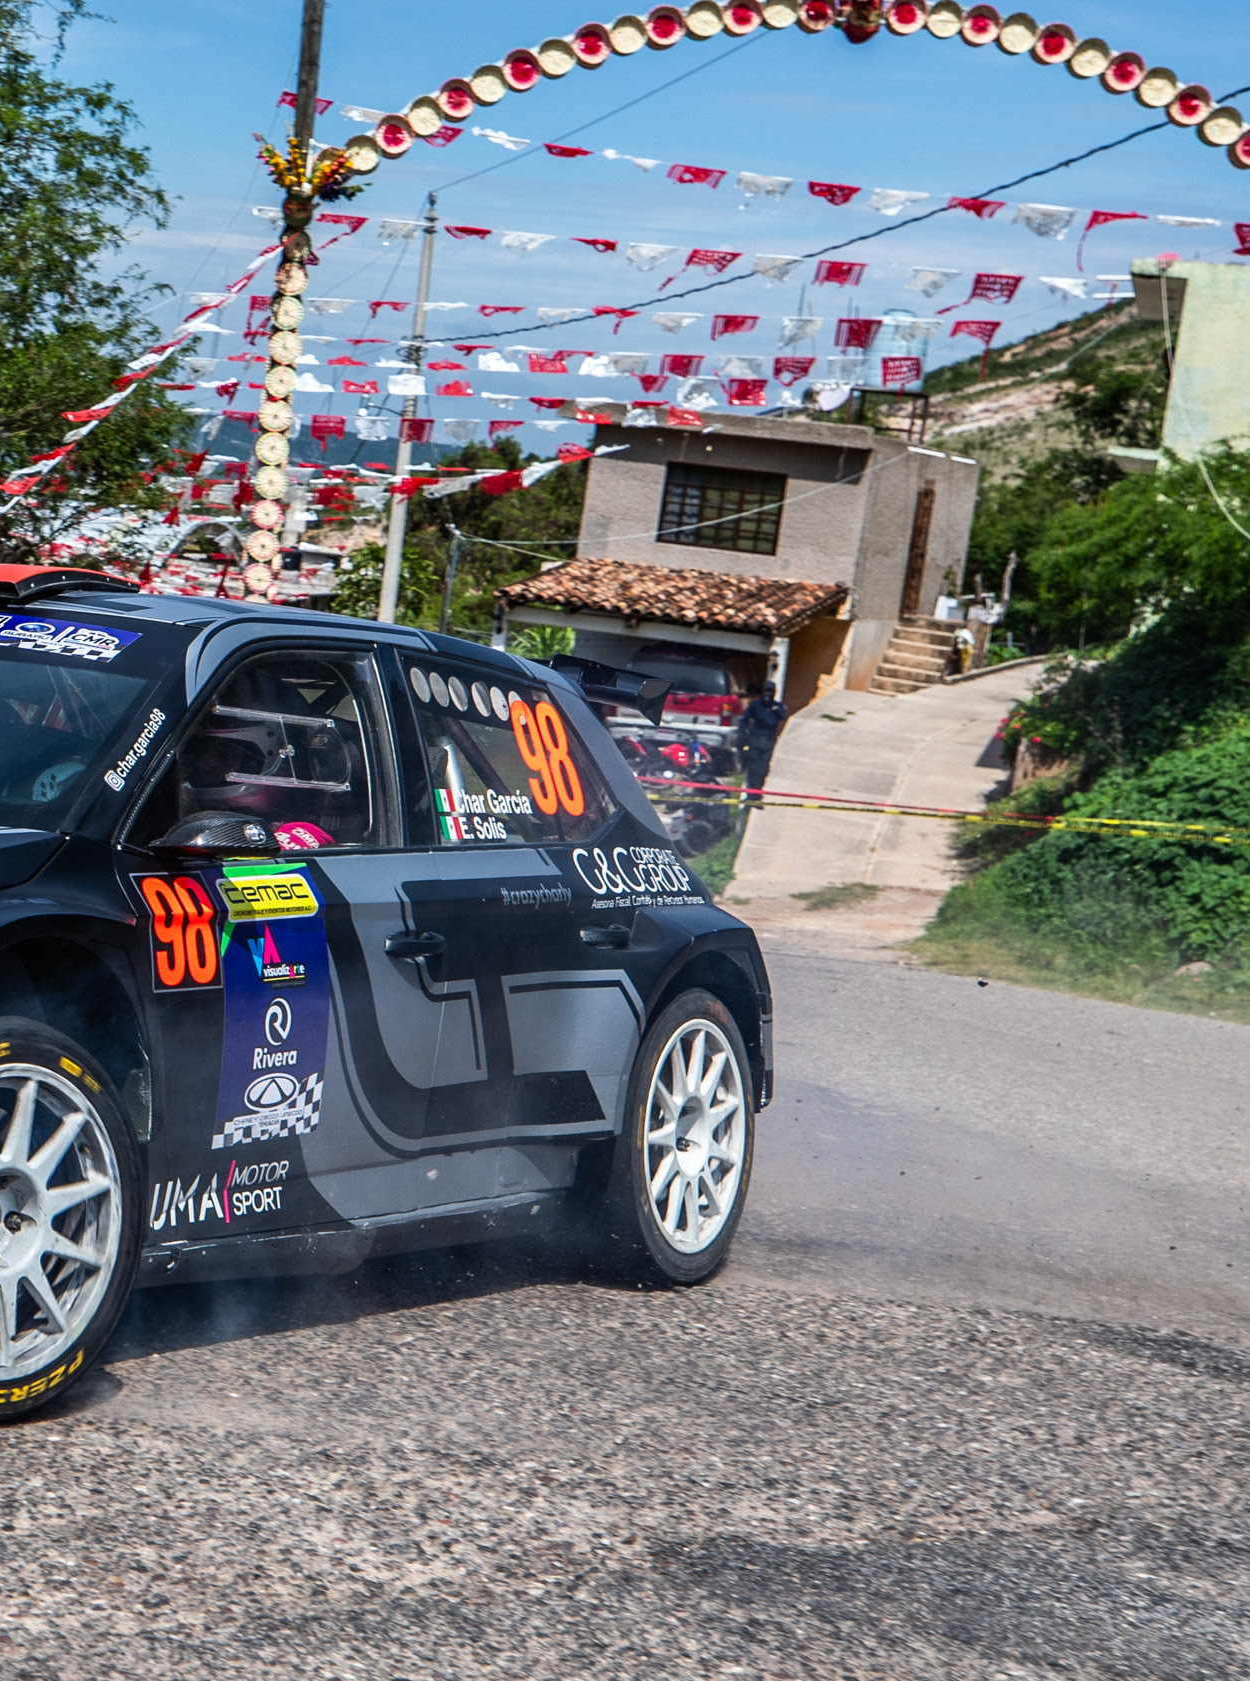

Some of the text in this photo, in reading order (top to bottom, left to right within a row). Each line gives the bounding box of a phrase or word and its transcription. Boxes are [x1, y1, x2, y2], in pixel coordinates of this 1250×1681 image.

[1, 630, 52, 640] SUBARU
[72, 633, 116, 647] CMR
[510, 699, 585, 817] 98
[455, 789, 485, 814] Char
[461, 818, 474, 839] E.
[630, 847, 680, 866] CORPORATE
[639, 864, 691, 892] GROUP
[141, 876, 218, 987] 98
[253, 1047, 298, 1070] Rivera
[230, 1160, 289, 1188] MOTOR
[149, 1173, 224, 1230] UMA
[232, 1186, 283, 1216] SPORT
